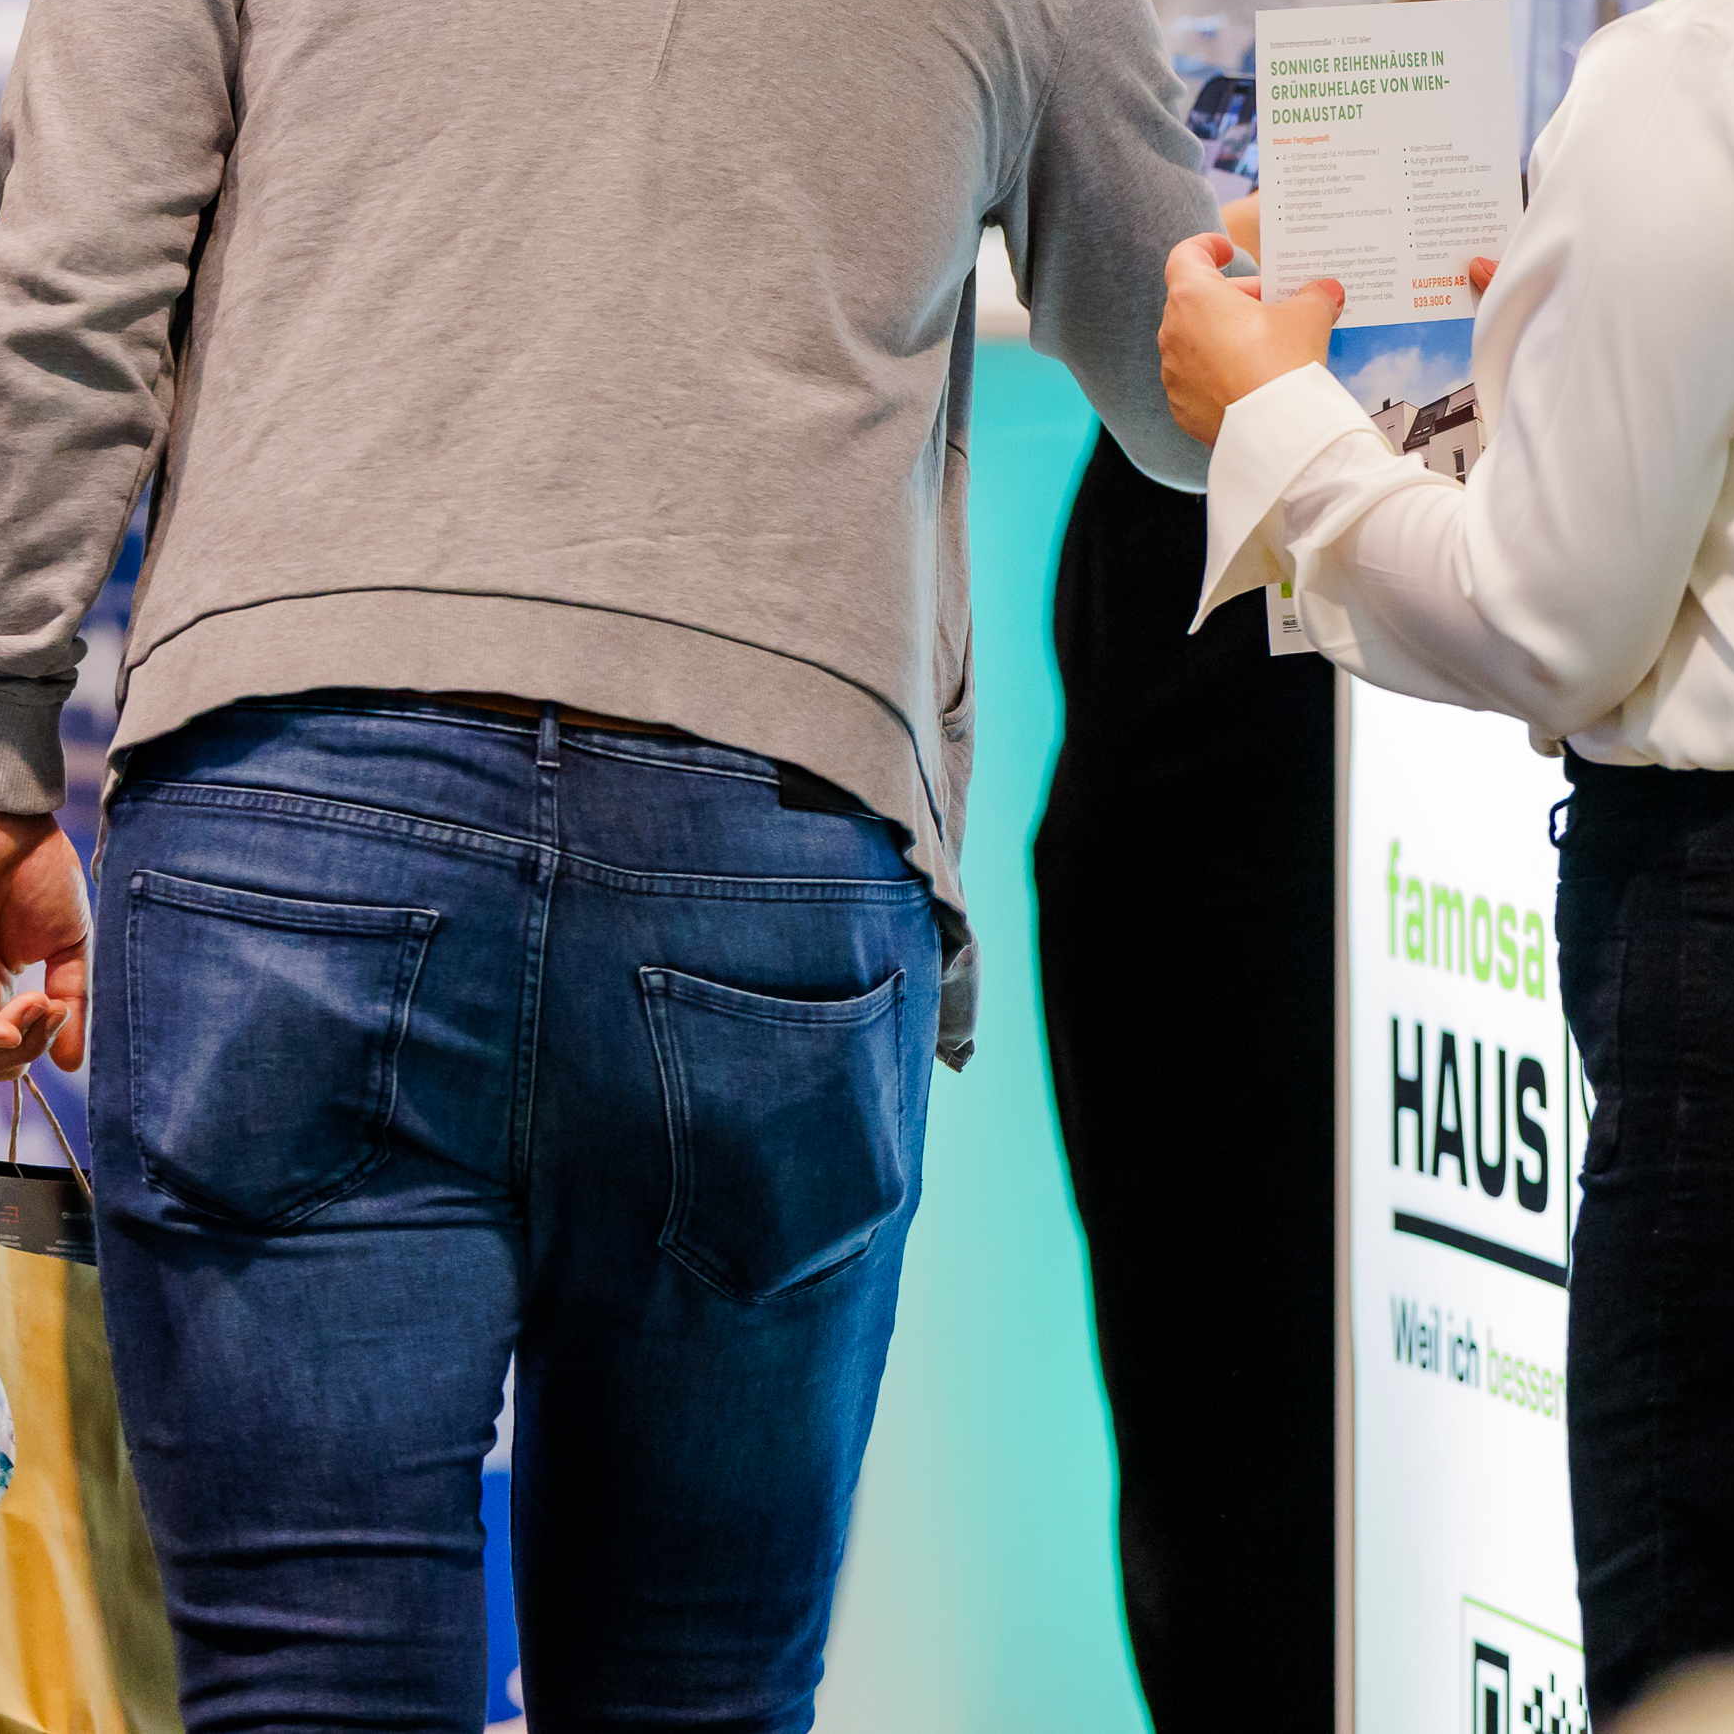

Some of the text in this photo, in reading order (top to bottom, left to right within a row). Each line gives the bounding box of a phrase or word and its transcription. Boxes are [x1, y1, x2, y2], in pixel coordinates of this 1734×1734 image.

[1271, 49, 1444, 76] SONNIGE REIHENHÄUSER IN
[1271, 74, 1450, 100] GRÜNRUHELAGE VON WIEN-
[1272, 103, 1363, 125] DONAUSTADT
[1412, 275, 1468, 289] KAUFPREIS AB:
[1413, 294, 1453, 308] 839.900 €
[1386, 839, 1546, 1000] famosa
[1389, 1018, 1550, 1216] HAUS
[1390, 1294, 1442, 1379] Weil
[1446, 1314, 1481, 1390] ich
